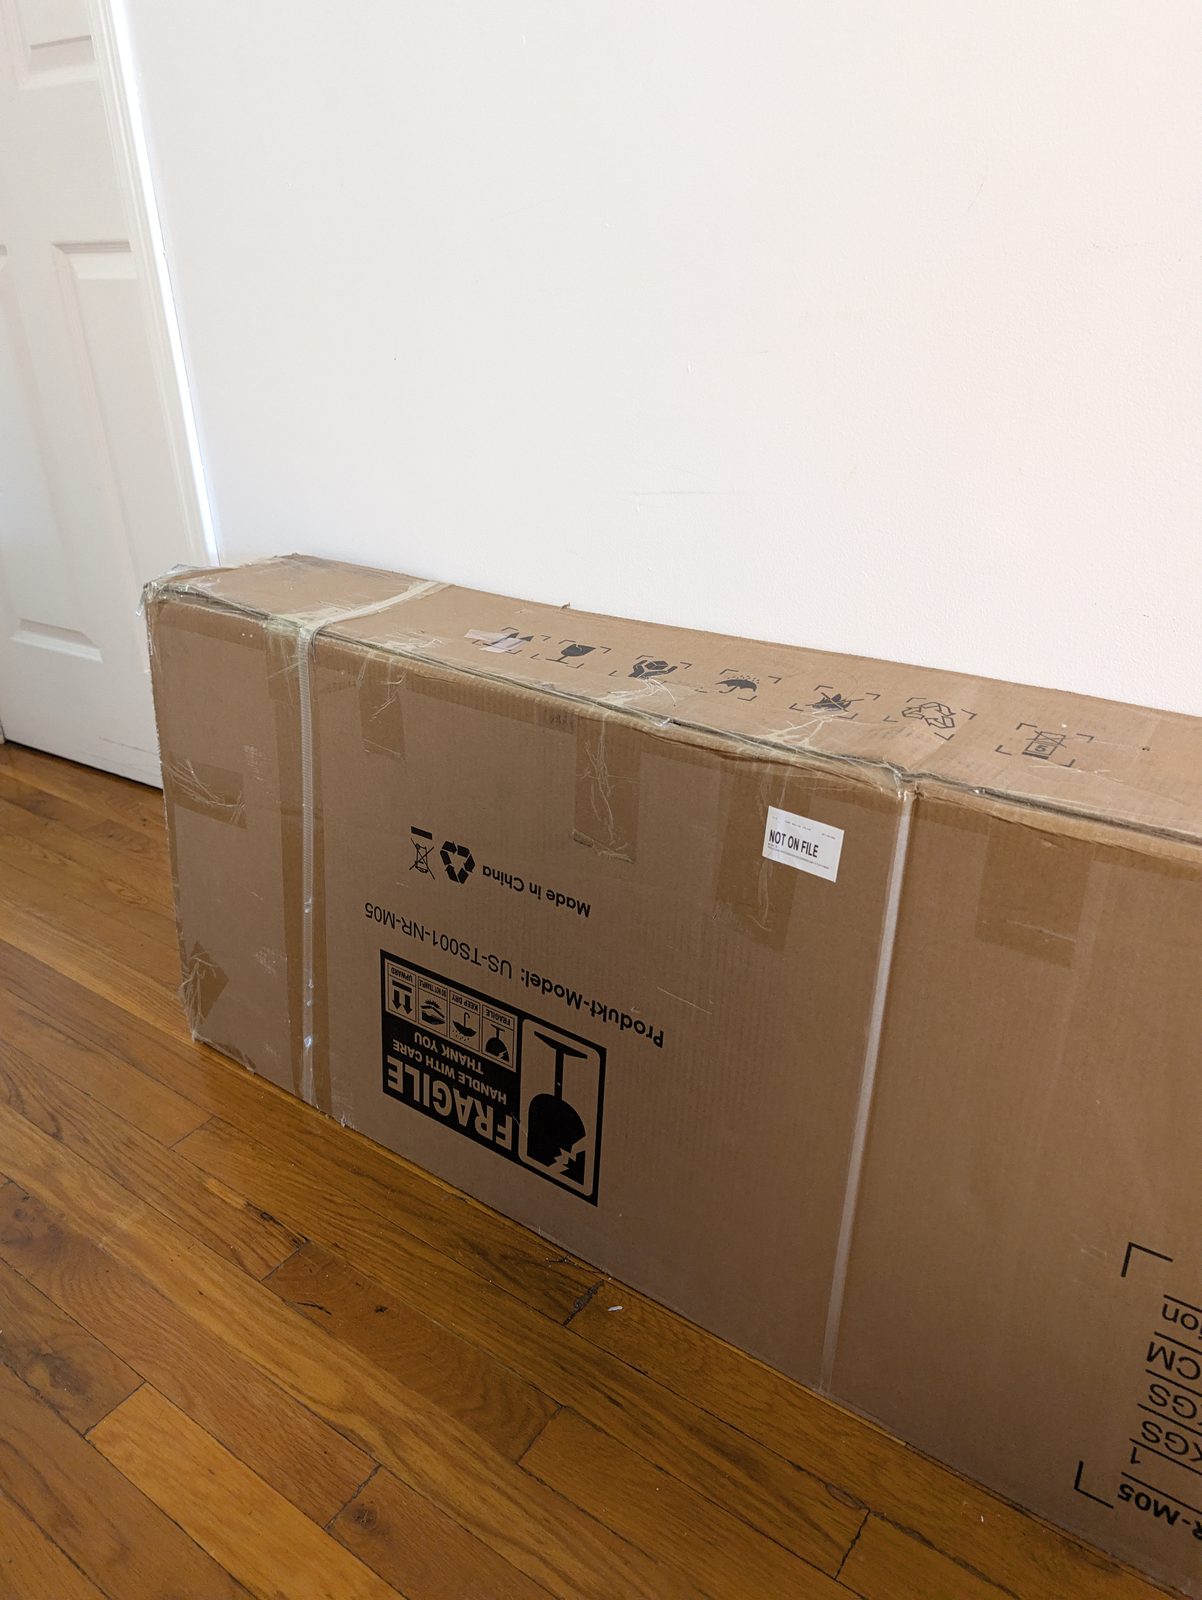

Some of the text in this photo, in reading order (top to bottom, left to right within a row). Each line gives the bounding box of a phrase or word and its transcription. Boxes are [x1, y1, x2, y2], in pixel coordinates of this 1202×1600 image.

[769, 829, 786, 847] NOT
[787, 835, 800, 852] ON
[801, 840, 819, 858] FILE
[482, 865, 591, 918] Made in China
[364, 902, 664, 1049] Produkt-Model: US-TS001-NR-M05
[390, 967, 413, 982] UPWARD
[451, 994, 479, 1012] KEEP DRY
[486, 1009, 511, 1026] FRAGILE
[392, 1039, 507, 1106] HANDLE WITH CARE
[414, 1031, 484, 1075] THANK YOU
[387, 1055, 513, 1151] FRAGILE
[1146, 1341, 1202, 1380] CM
[1149, 1384, 1202, 1425] GS
[1130, 1446, 1141, 1465] 1
